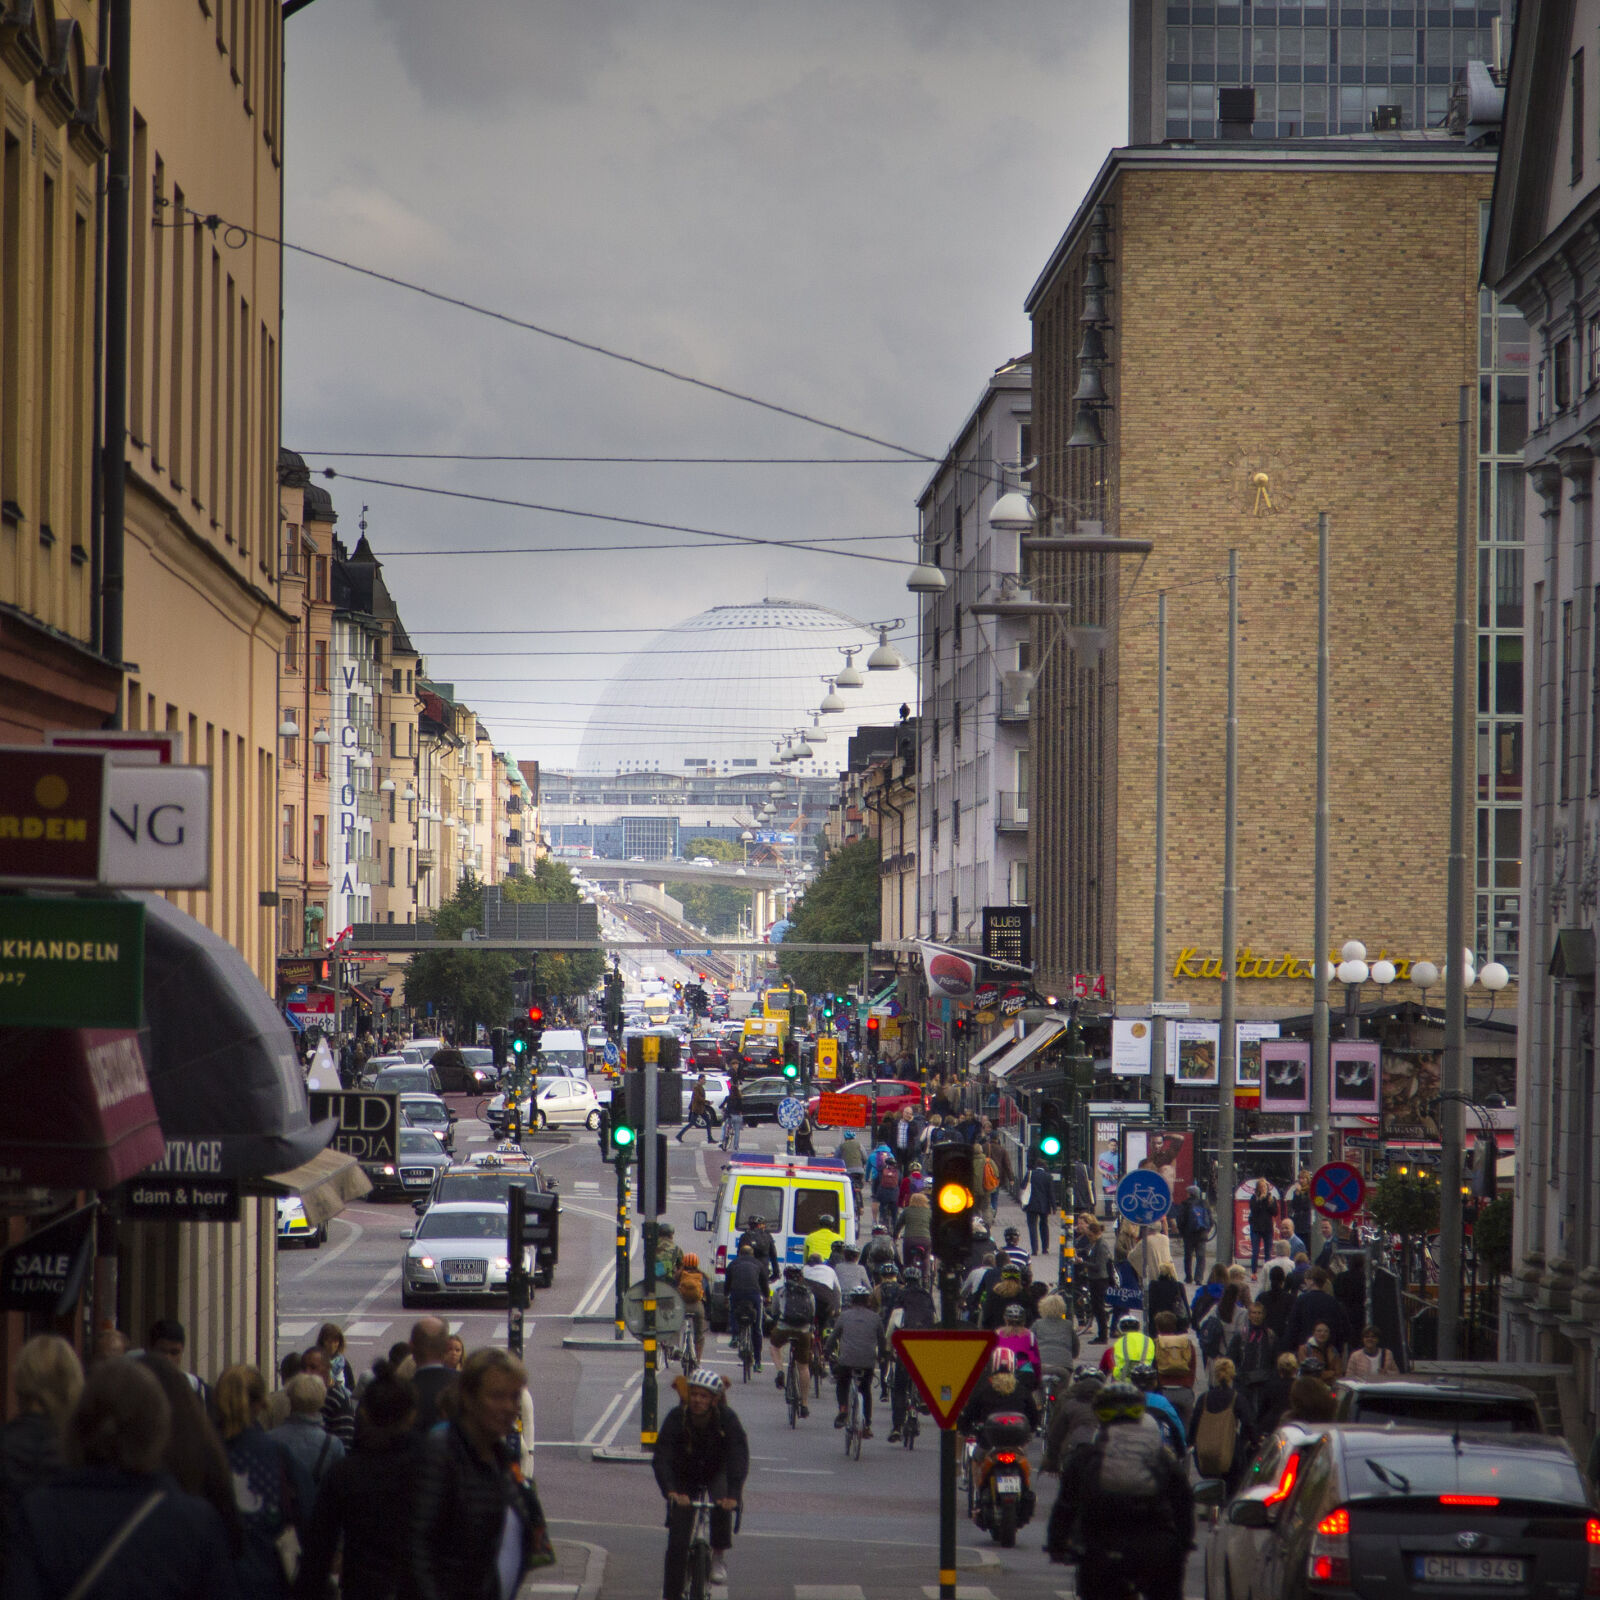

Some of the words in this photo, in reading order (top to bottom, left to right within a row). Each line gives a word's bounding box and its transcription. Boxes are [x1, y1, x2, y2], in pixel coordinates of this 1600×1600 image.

[340, 666, 356, 894] VICTORIA
[990, 915, 1021, 928] KLUBB
[0, 940, 119, 961] KHANDELN
[1074, 974, 1107, 998] 54
[331, 1135, 393, 1159] EDJA
[132, 1188, 170, 1204] dam
[175, 1190, 188, 1204] &
[193, 1188, 228, 1204] herr
[13, 1255, 70, 1276] SALE
[1427, 1558, 1465, 1577] CHL
[1480, 1560, 1520, 1579] 949
